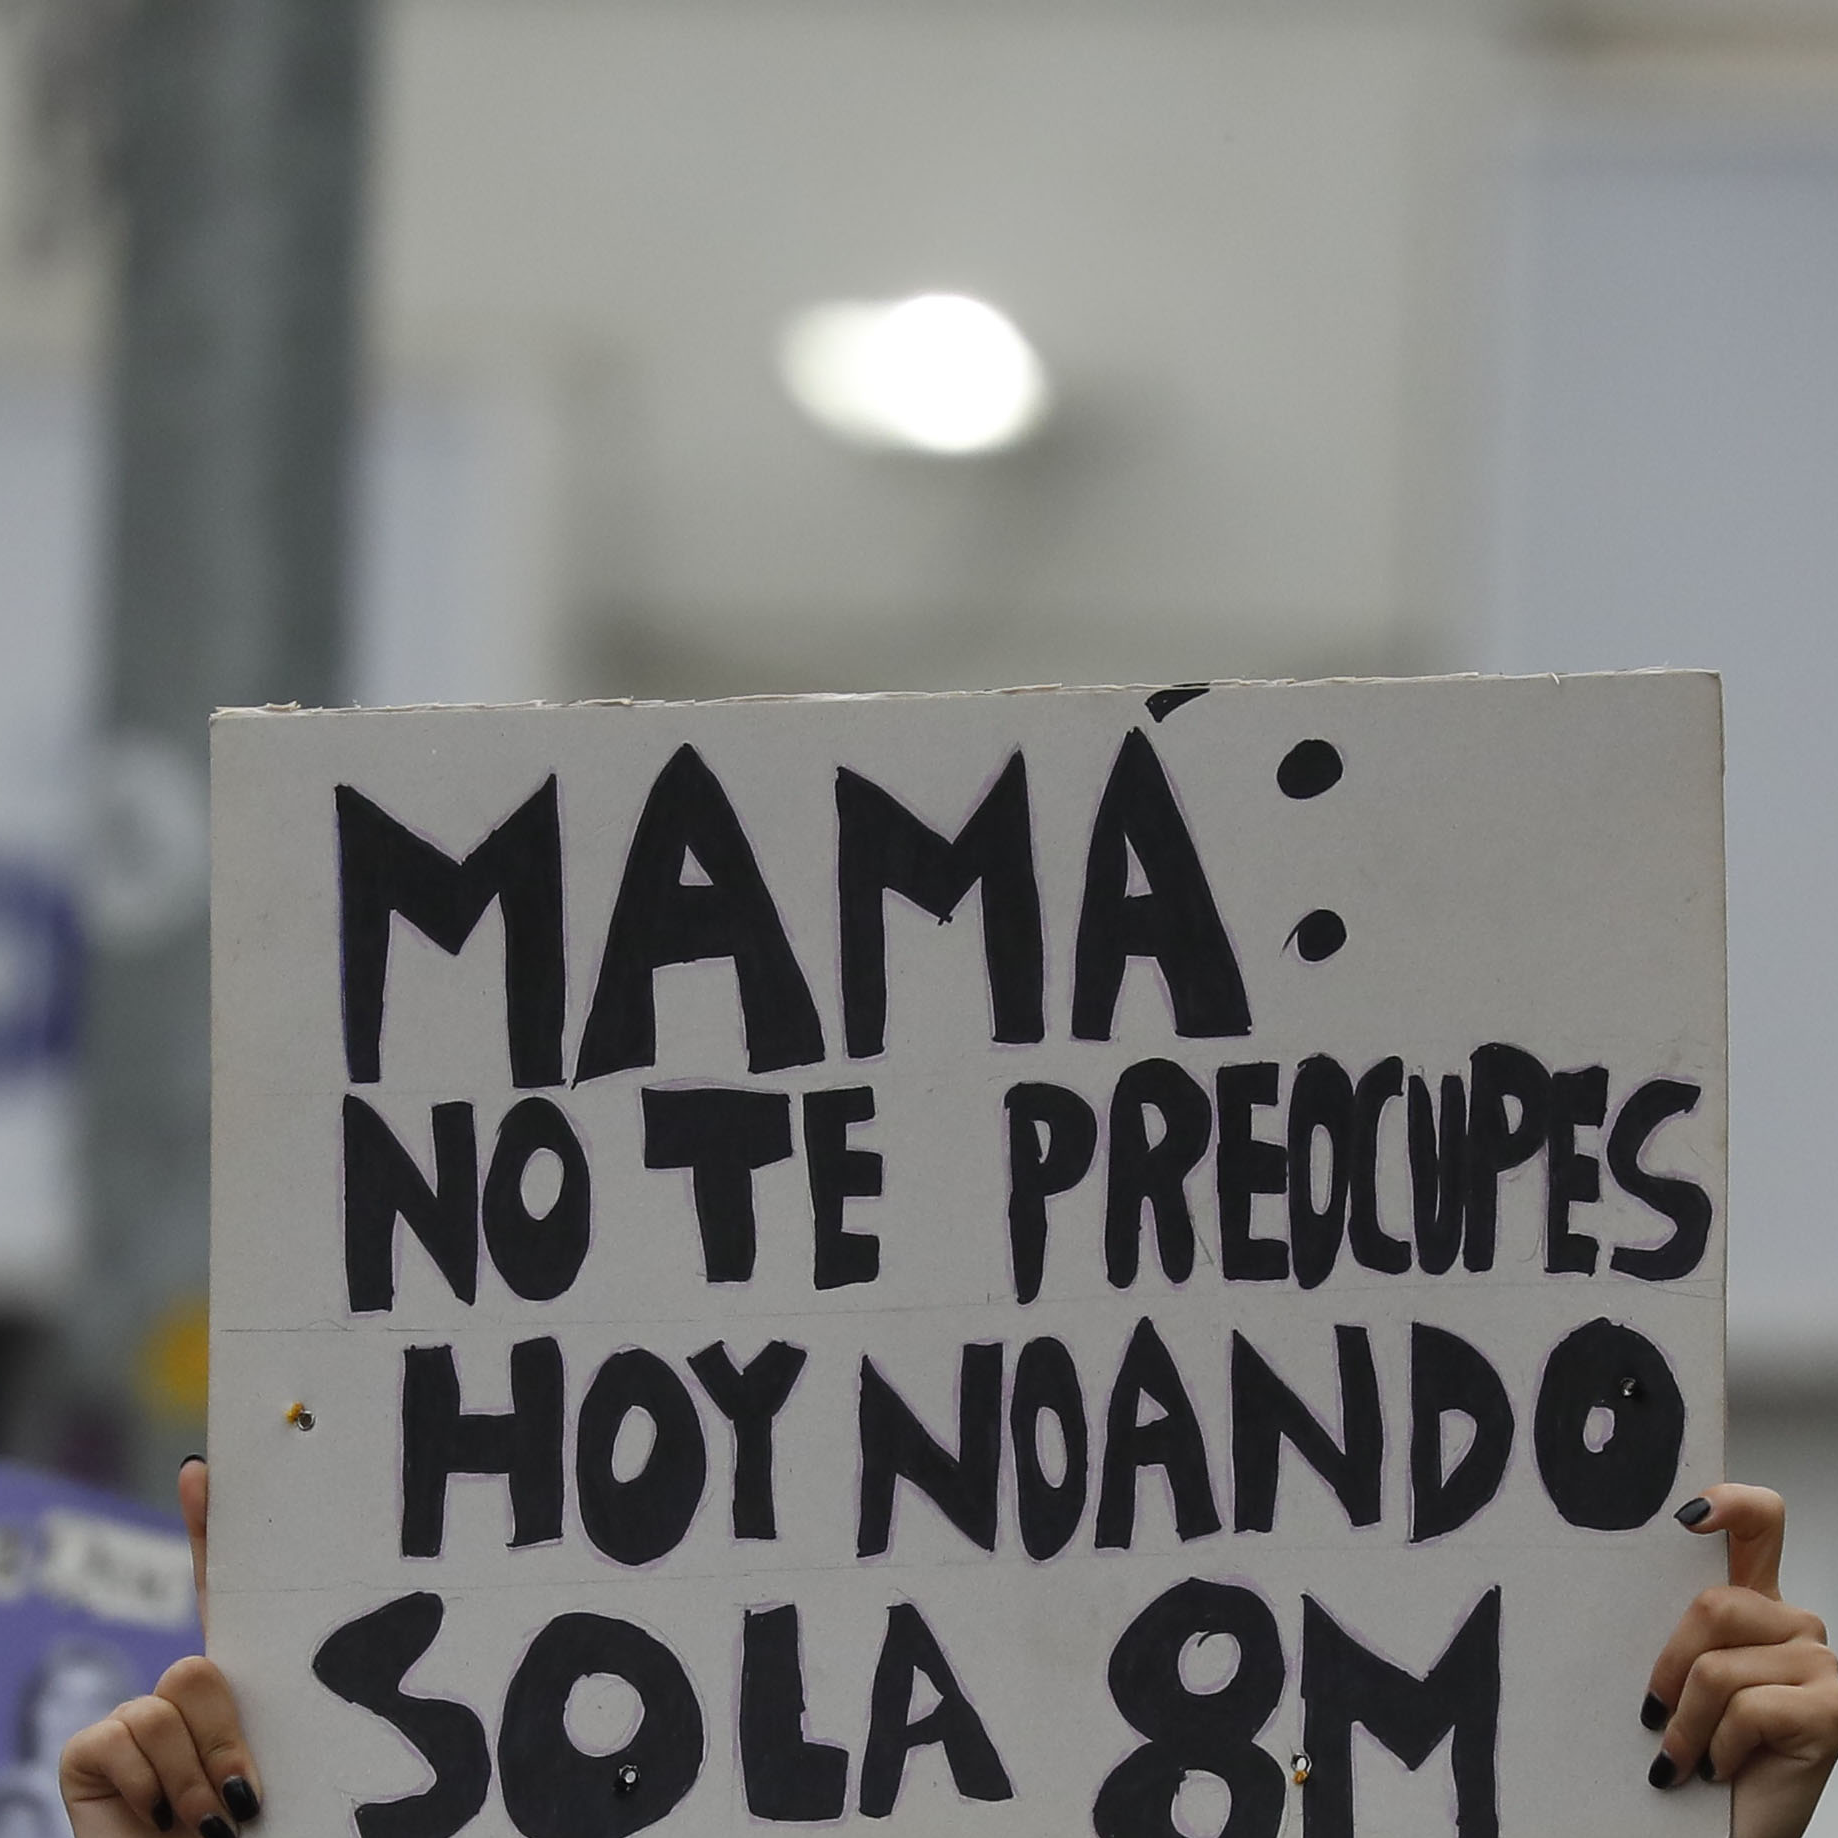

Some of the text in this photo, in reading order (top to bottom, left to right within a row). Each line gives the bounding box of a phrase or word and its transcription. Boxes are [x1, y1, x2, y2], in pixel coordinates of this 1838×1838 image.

[342, 1042, 1714, 1313] NO TE PREOCUPES
[400, 1336, 808, 1567] HOY
